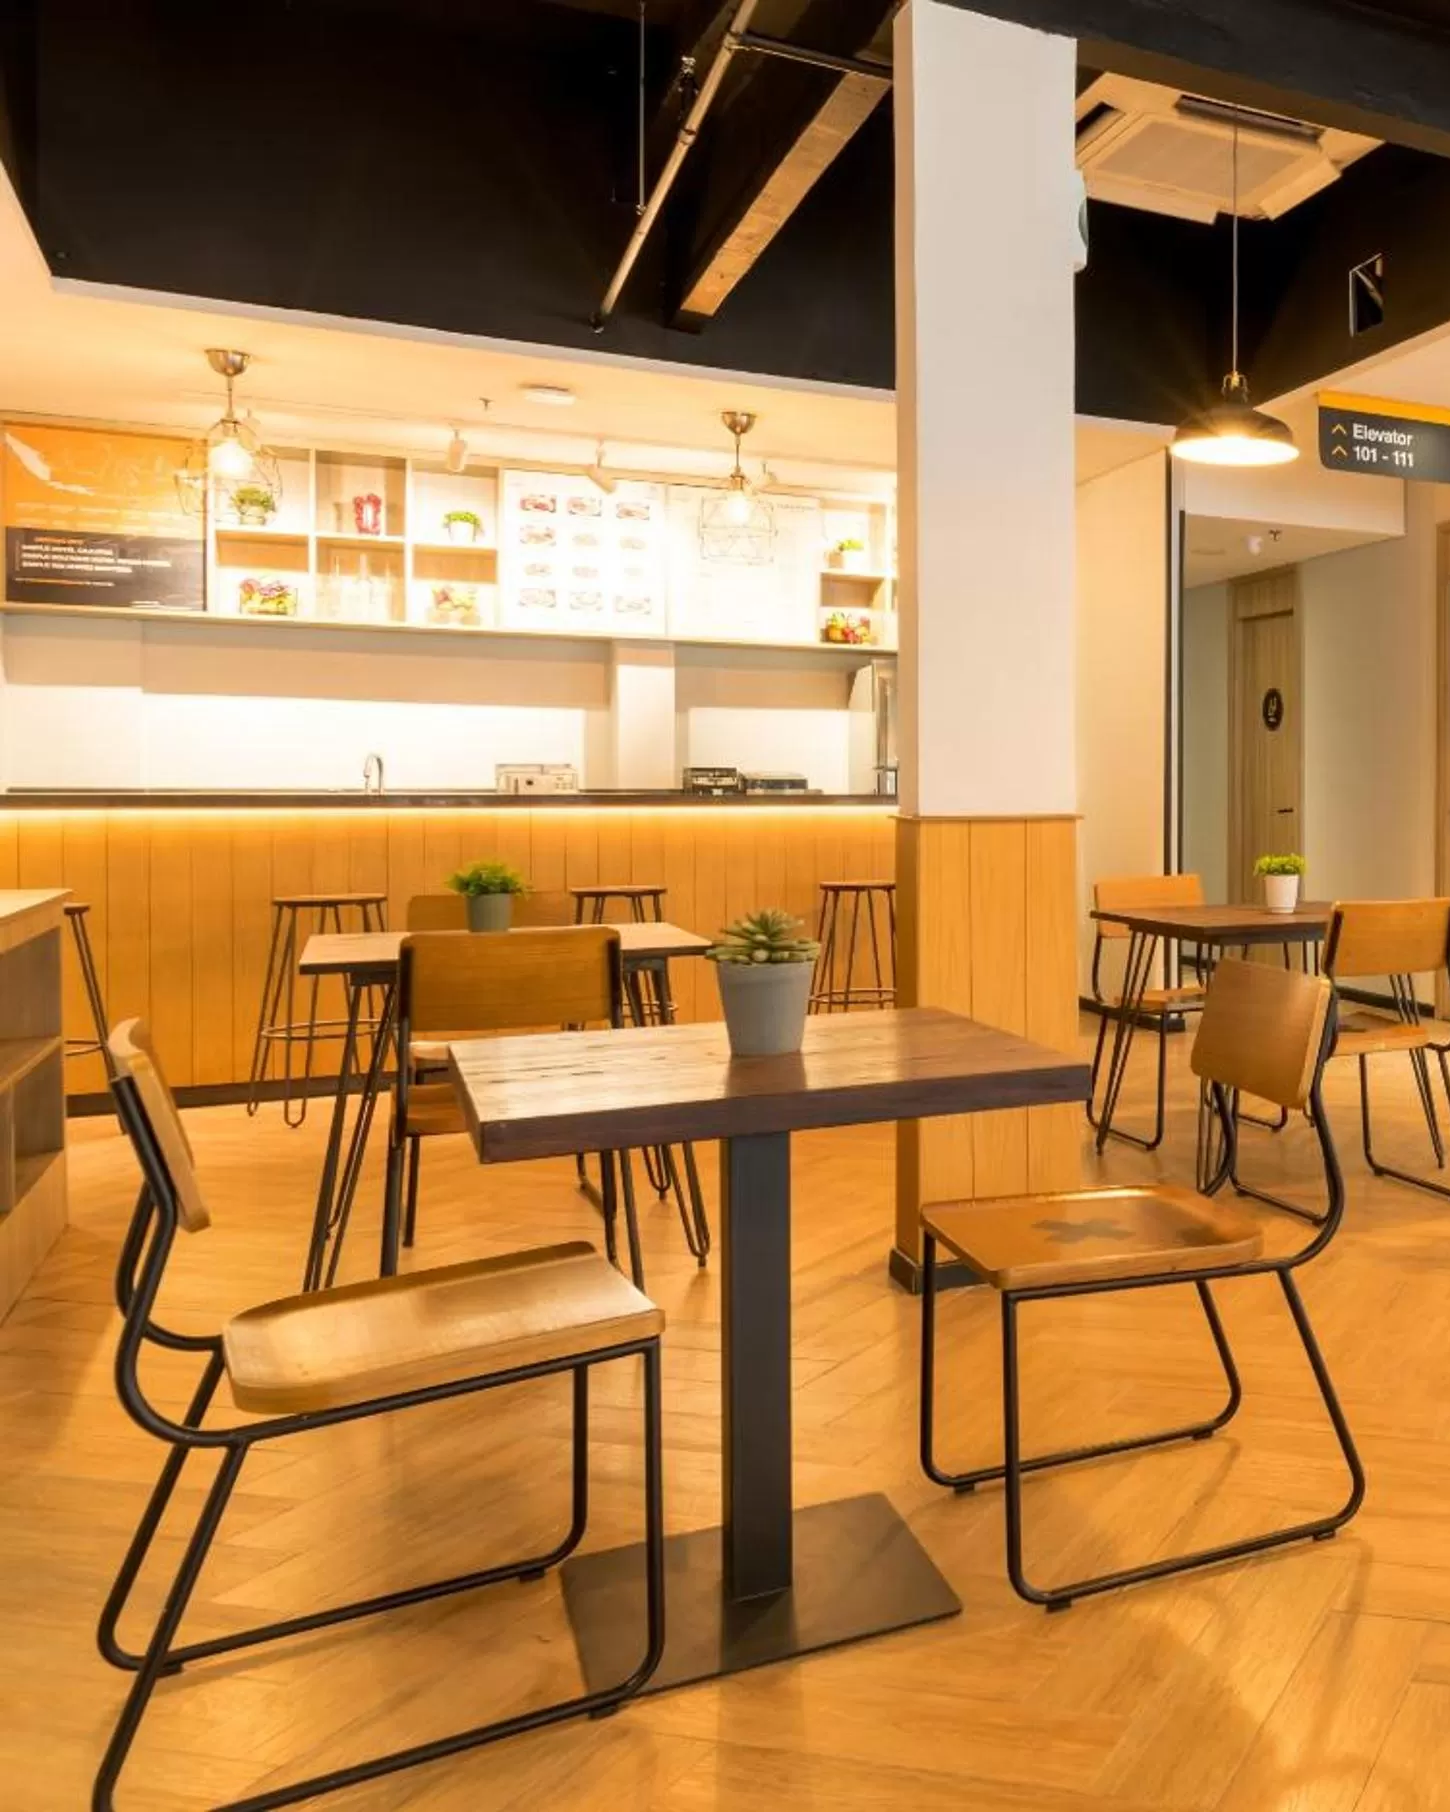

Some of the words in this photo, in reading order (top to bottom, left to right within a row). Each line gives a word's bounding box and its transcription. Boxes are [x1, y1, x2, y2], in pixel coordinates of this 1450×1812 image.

[1353, 424, 1413, 446] Elevator
[1354, 446, 1378, 462] 101
[1394, 451, 1413, 468] 111
